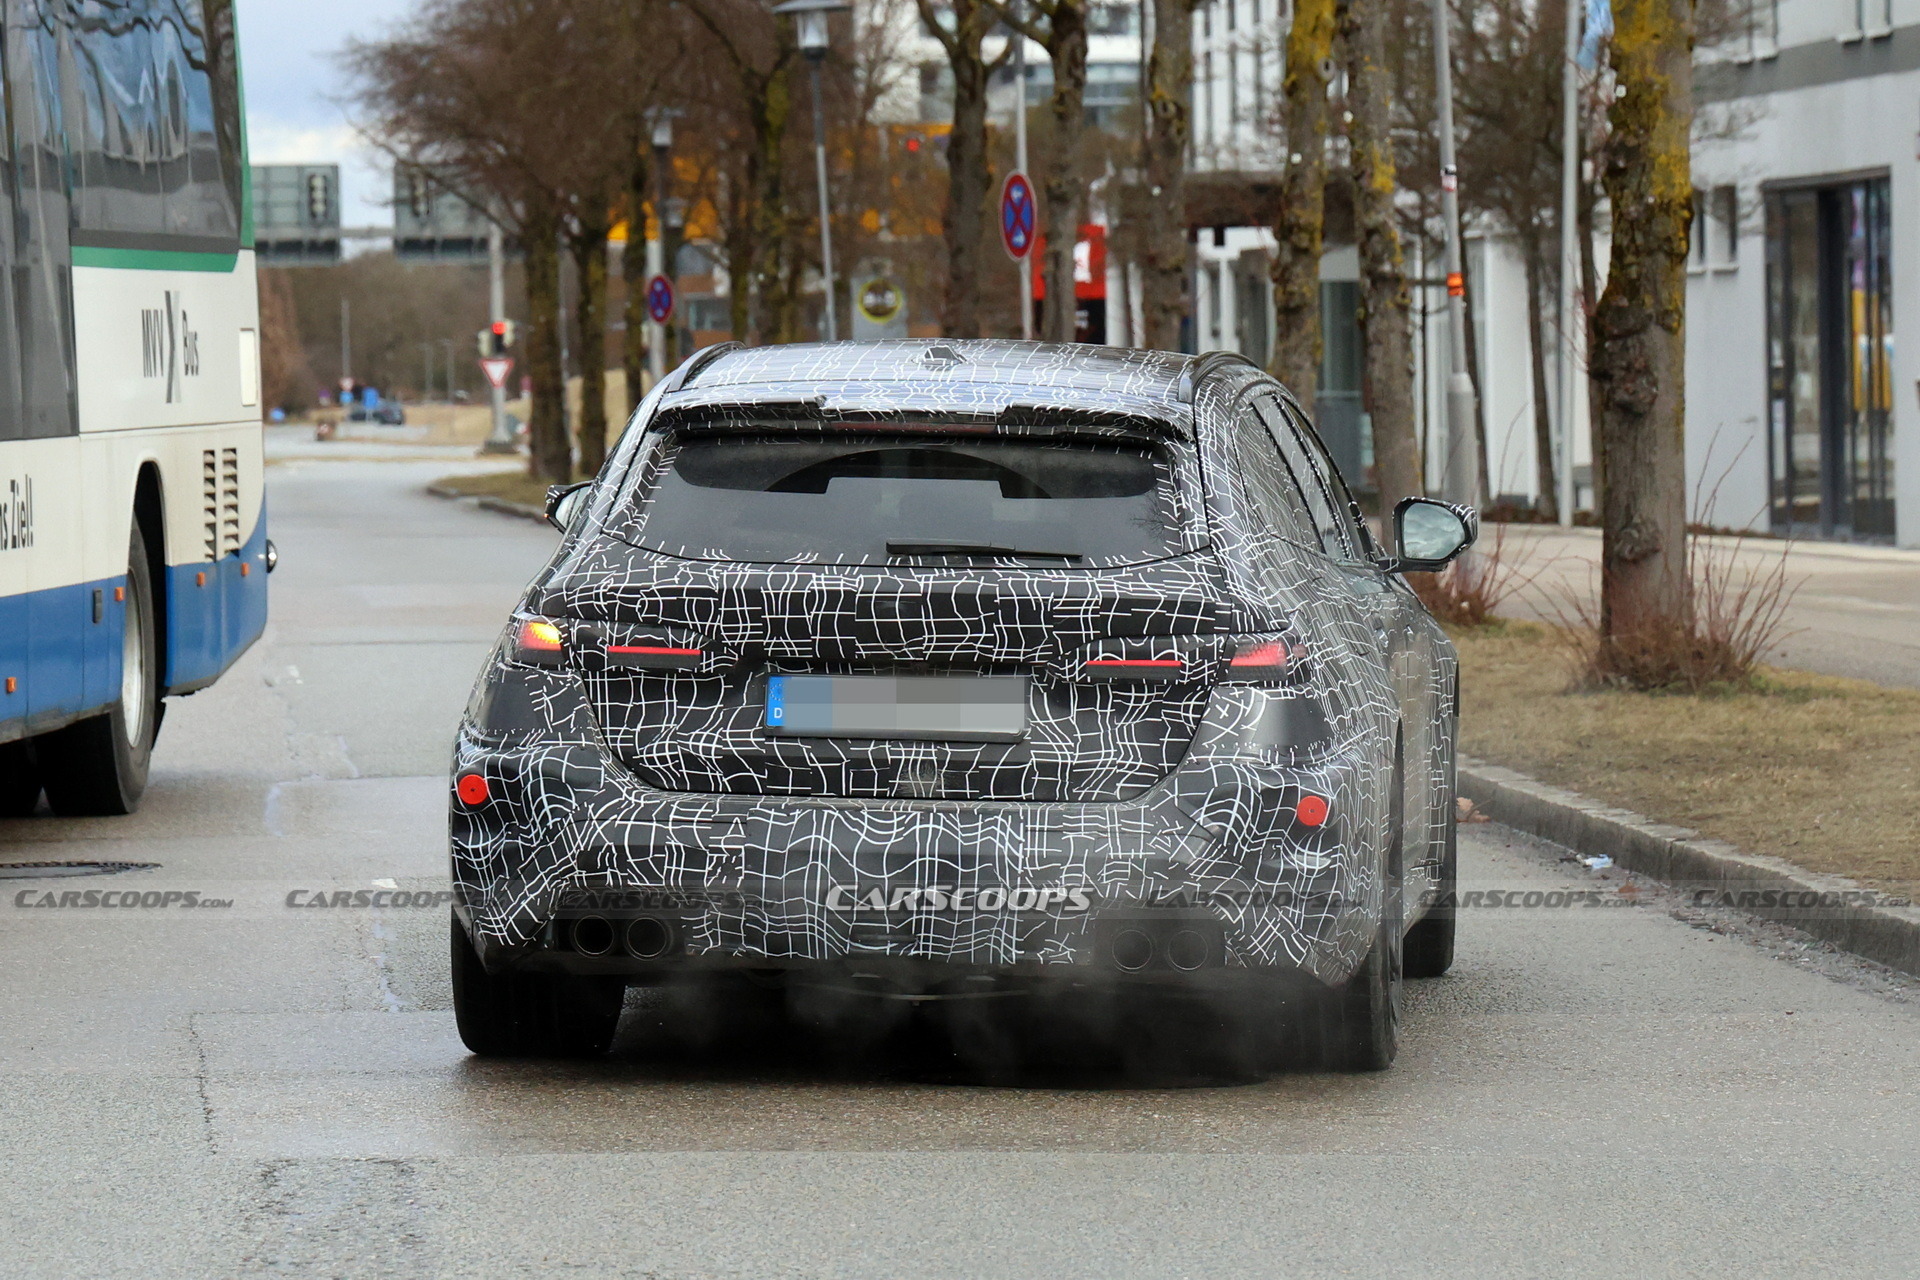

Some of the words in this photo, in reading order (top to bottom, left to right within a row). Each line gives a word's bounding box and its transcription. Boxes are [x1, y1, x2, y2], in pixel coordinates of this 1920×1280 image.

[141, 308, 164, 378] MVV
[182, 309, 199, 376] Bus
[10, 473, 34, 549] Ziel!
[773, 707, 783, 719] D
